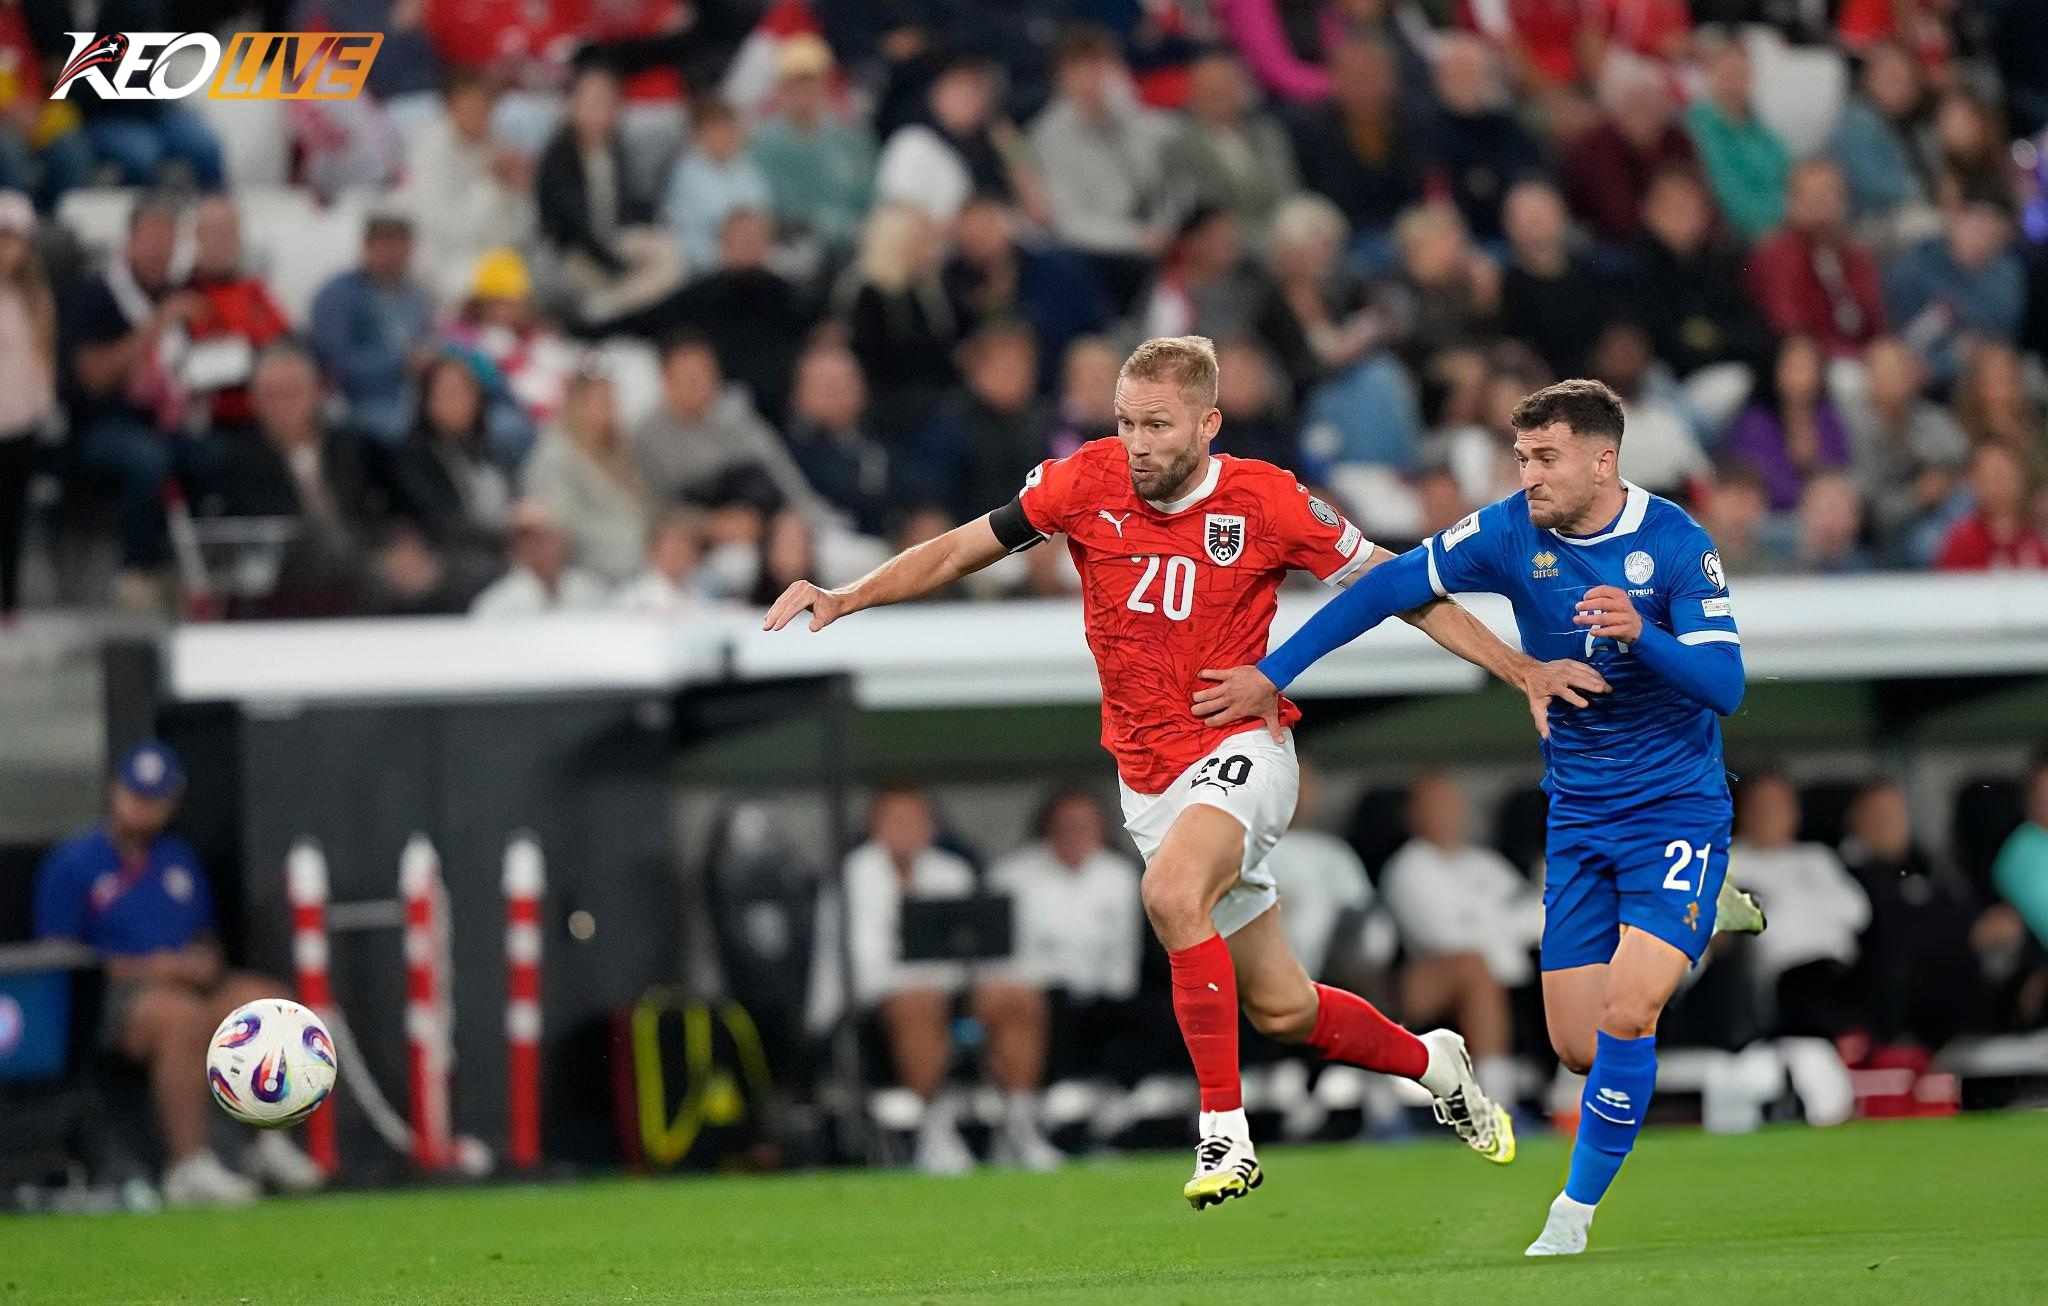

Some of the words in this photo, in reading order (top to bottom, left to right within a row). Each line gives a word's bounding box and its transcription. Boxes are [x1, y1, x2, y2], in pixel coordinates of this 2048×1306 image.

[1126, 554, 1197, 621] 20
[1627, 587, 1655, 597] CYPRUS
[1662, 839, 1712, 897] 21
